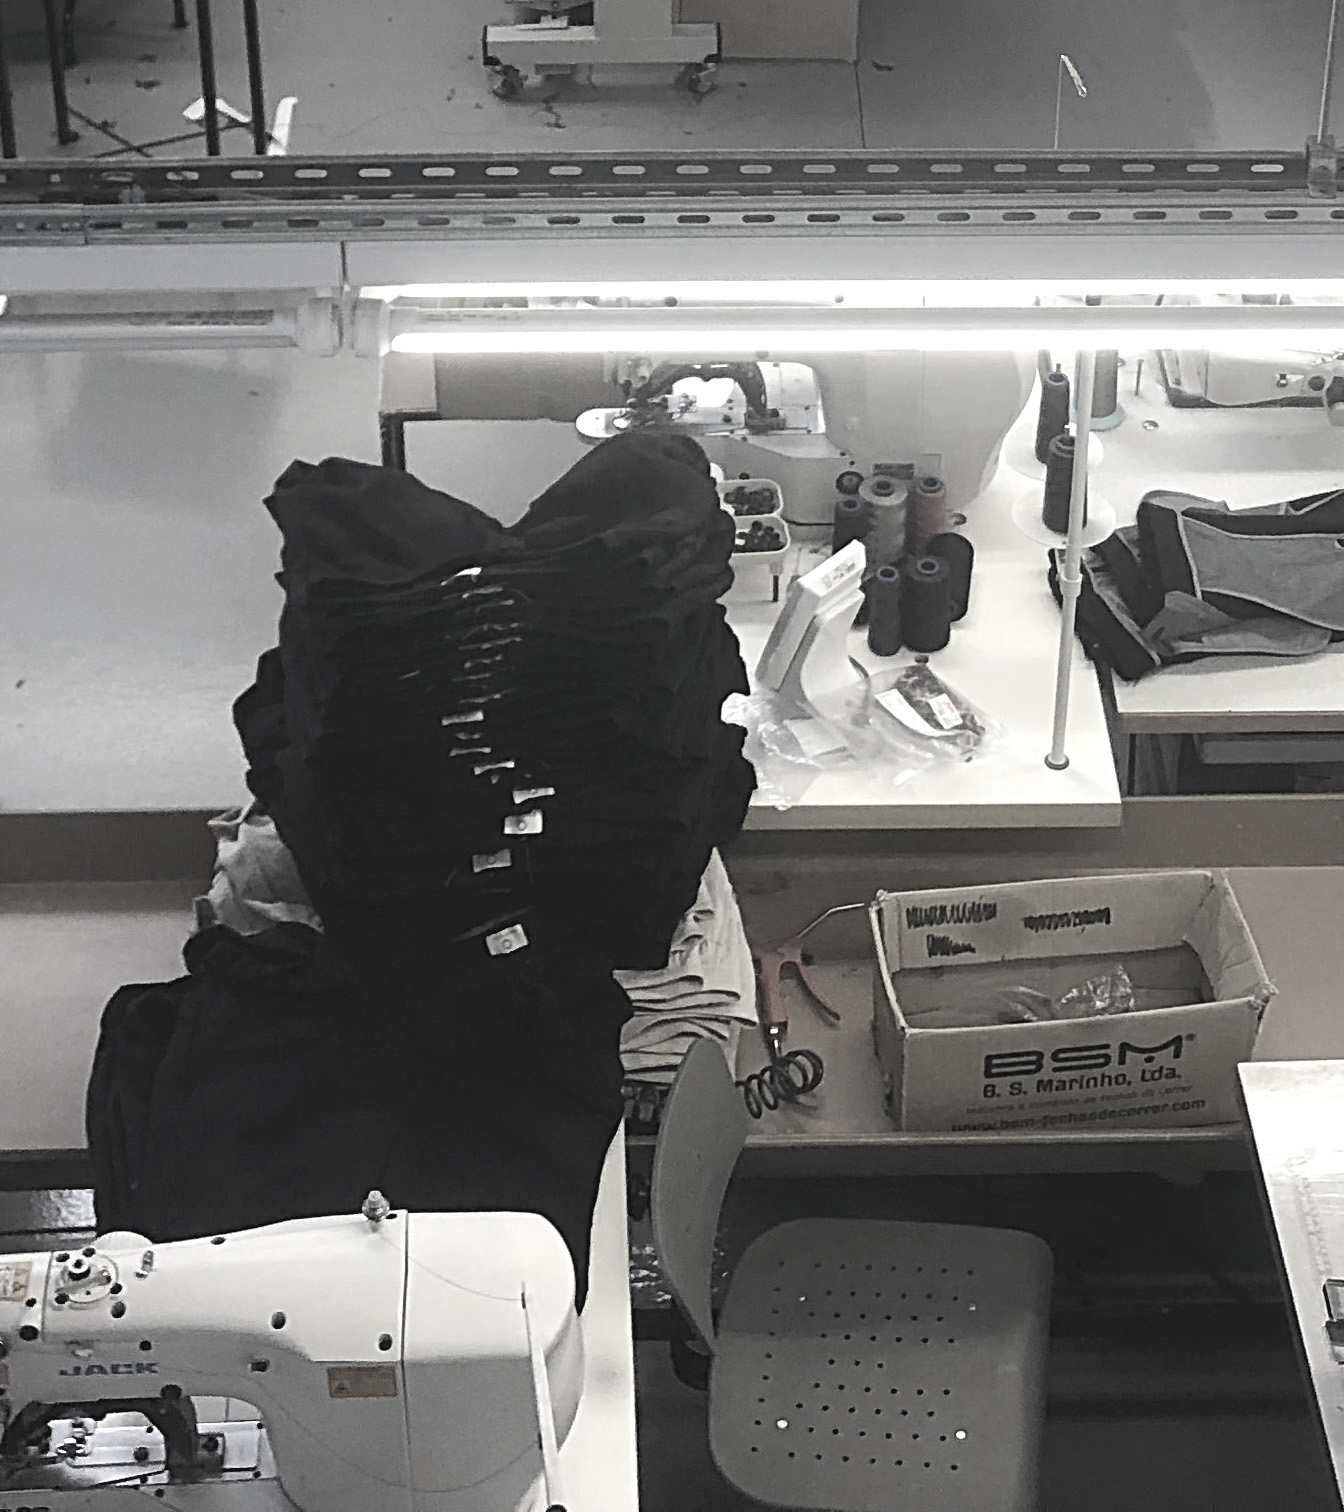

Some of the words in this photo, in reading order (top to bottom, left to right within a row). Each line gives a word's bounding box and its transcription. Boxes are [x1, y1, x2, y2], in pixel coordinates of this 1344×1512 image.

[983, 1034, 1184, 1080] BSM
[982, 1082, 1002, 1099] B.
[1008, 1080, 1029, 1097] S.
[1035, 1070, 1132, 1094] Marinho,
[1140, 1065, 1182, 1084] Lda.
[58, 1362, 160, 1377] JACK
